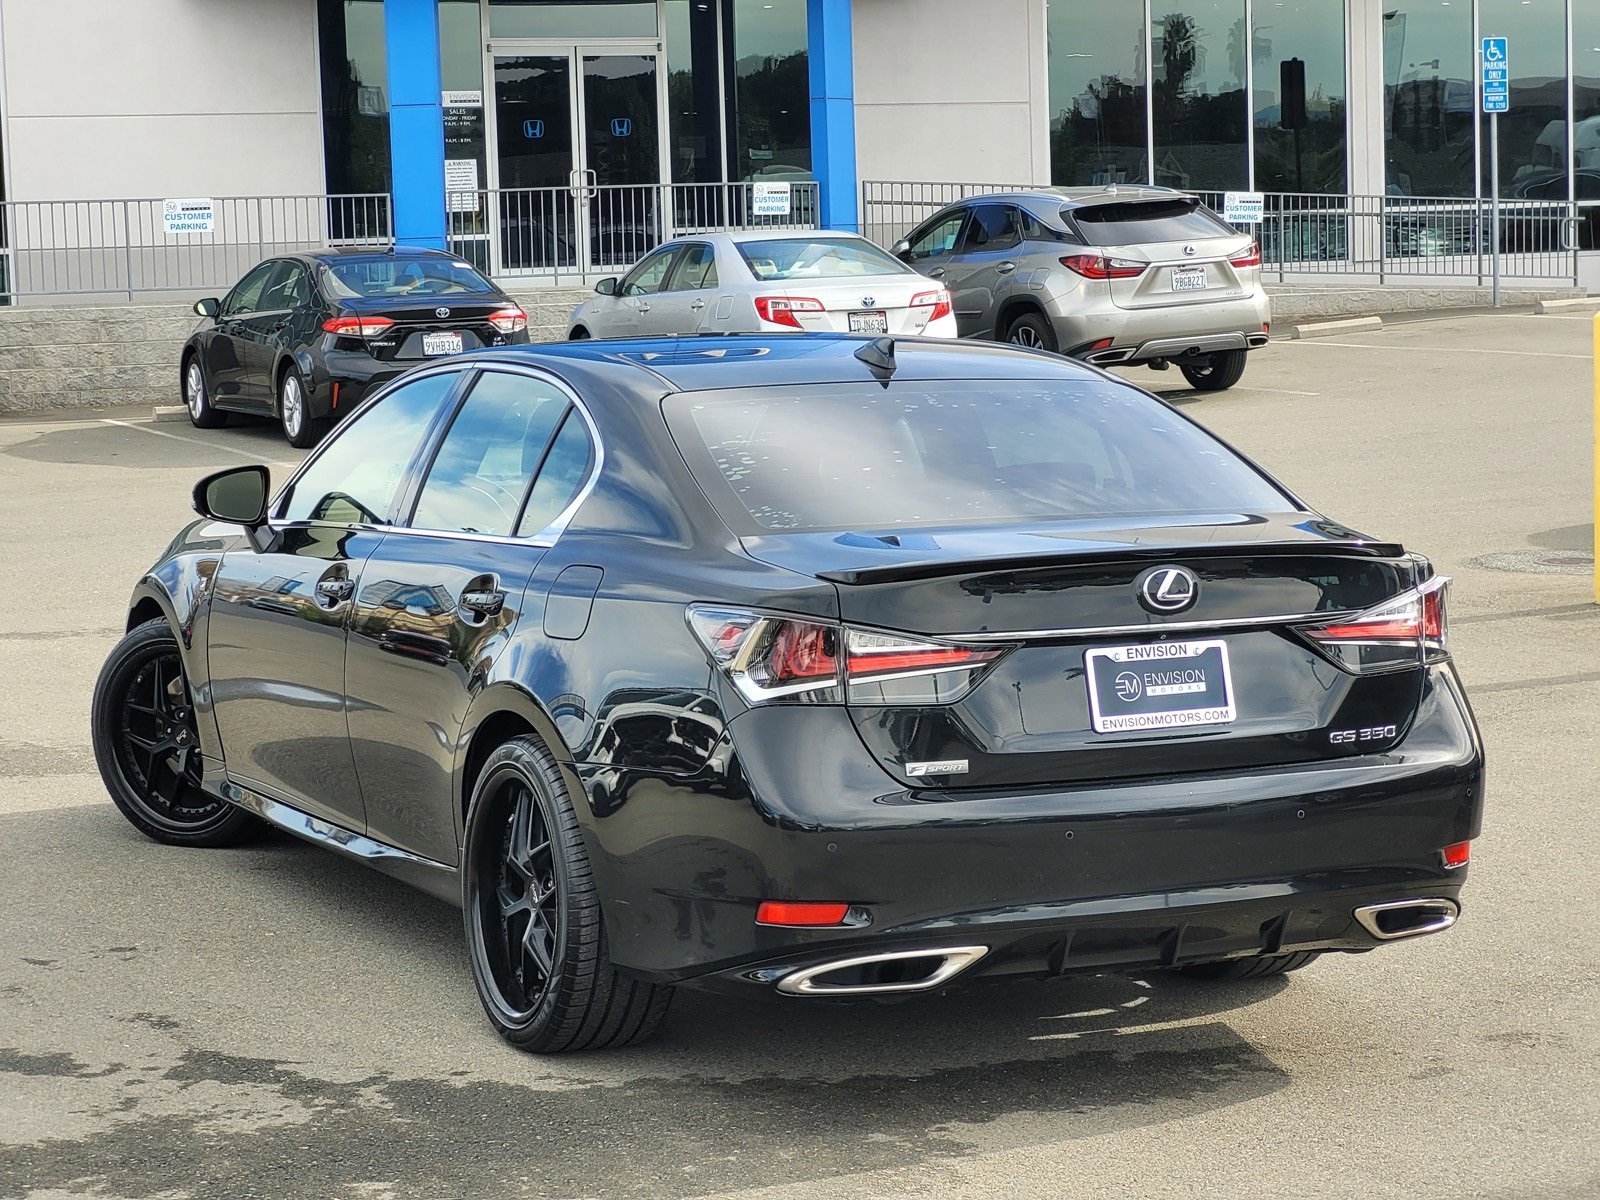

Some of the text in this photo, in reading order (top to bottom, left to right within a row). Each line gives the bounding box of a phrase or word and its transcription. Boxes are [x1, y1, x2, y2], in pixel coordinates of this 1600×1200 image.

[1488, 71, 1502, 79] ONLY
[1175, 276, 1204, 288] 9BGB227
[852, 319, 884, 330] 7DJN638
[426, 340, 461, 351] 9VHB316
[1126, 644, 1187, 659] ENVISION
[1144, 669, 1205, 686] ENVISION
[1151, 685, 1202, 694] MOTORS
[1102, 710, 1229, 729] ENVISIONMOTORS.COM
[1330, 725, 1396, 743] GS 350
